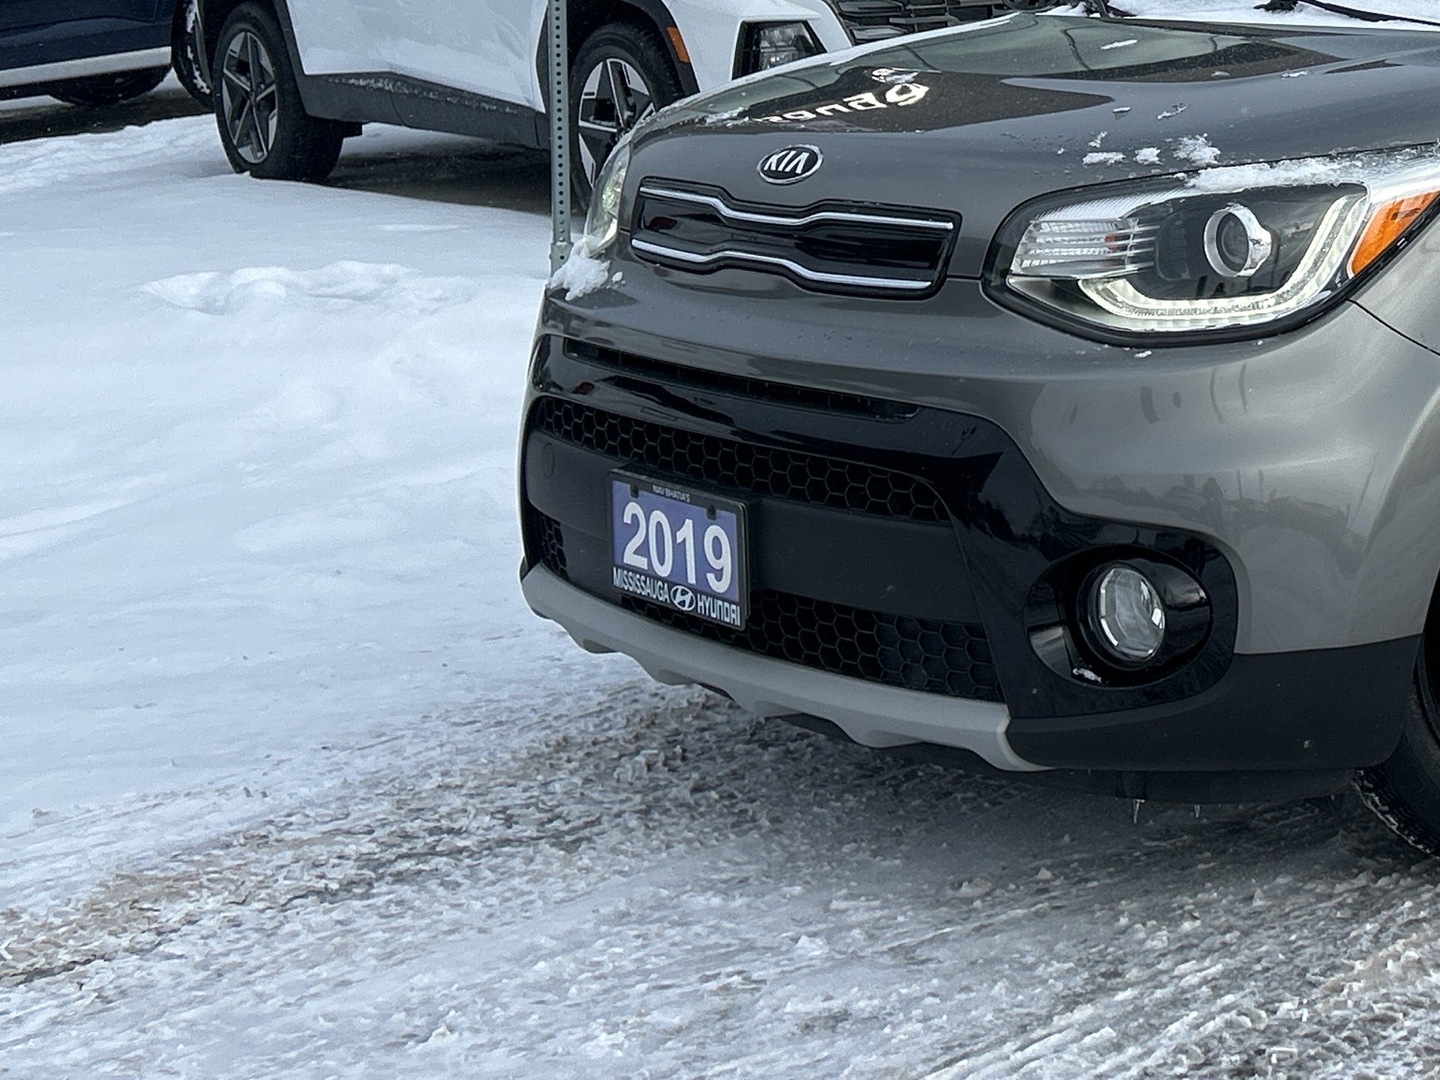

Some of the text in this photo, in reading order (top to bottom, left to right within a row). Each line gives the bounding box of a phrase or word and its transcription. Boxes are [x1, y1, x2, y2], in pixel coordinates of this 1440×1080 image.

[763, 150, 810, 174] KIA
[622, 501, 732, 594] 2019
[612, 566, 741, 627] MISSISSAUGA HYUNDAI
